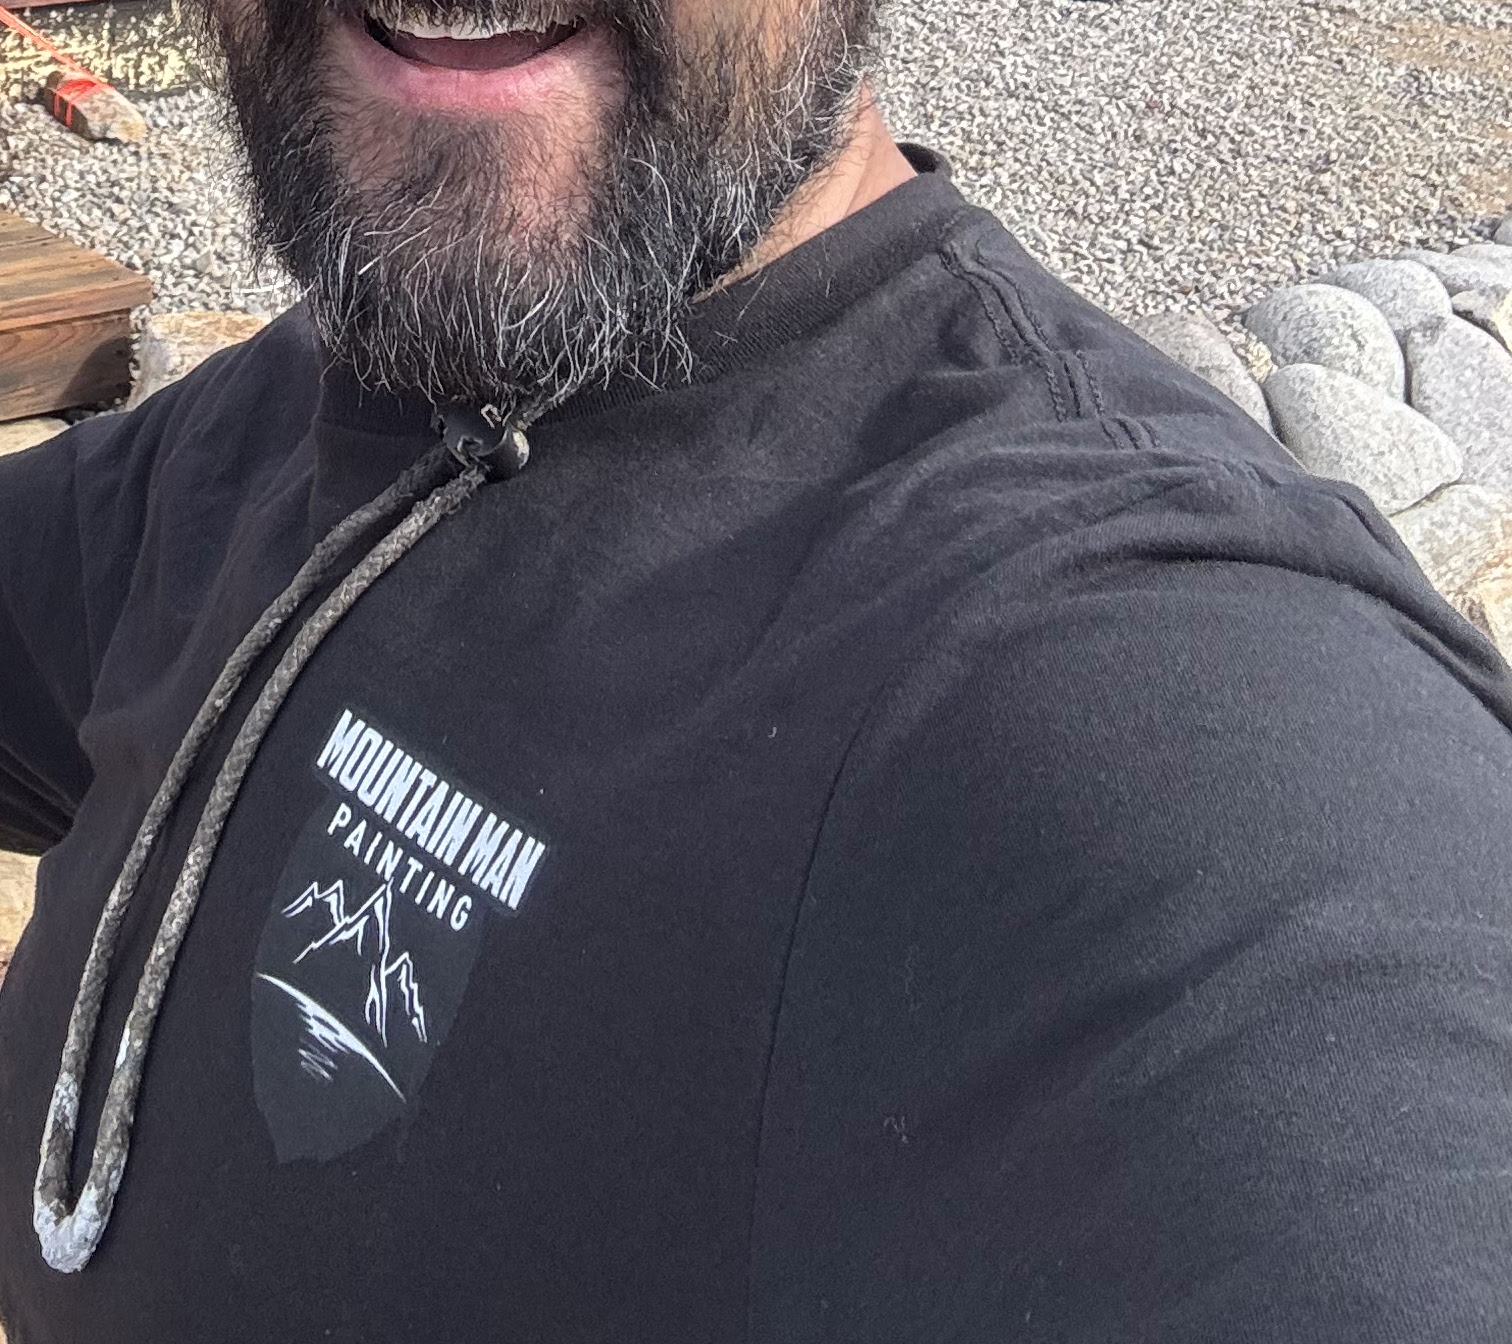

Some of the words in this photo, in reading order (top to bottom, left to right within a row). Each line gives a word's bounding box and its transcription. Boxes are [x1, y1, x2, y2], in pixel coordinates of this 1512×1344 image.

[316, 709, 483, 867] MOUNTAIN
[458, 812, 545, 911] MAN
[327, 802, 473, 932] PAINTING
